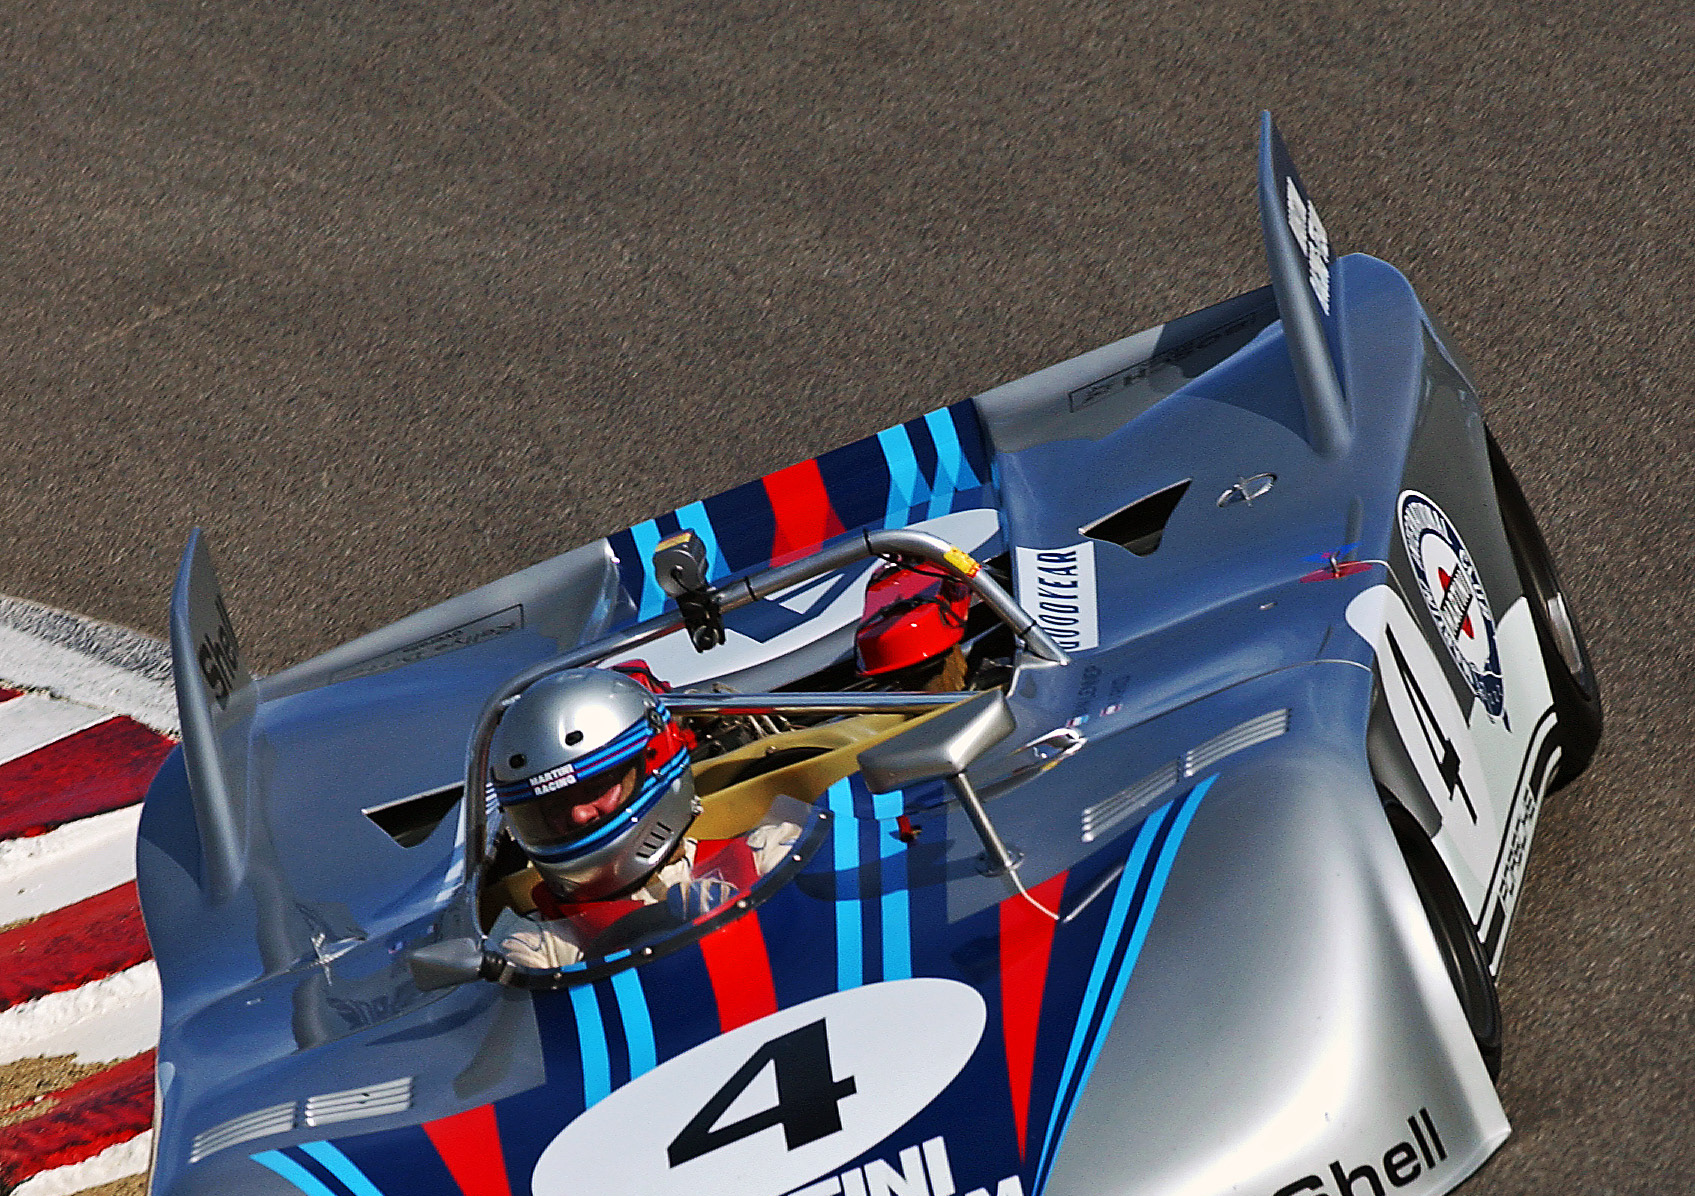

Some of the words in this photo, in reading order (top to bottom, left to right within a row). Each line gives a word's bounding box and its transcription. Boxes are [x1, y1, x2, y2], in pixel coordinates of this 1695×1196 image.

[198, 594, 240, 711] Shell
[529, 763, 575, 786] MARTINI
[1385, 623, 1477, 825] 4
[534, 774, 577, 796] RACING
[668, 1017, 857, 1169] 4
